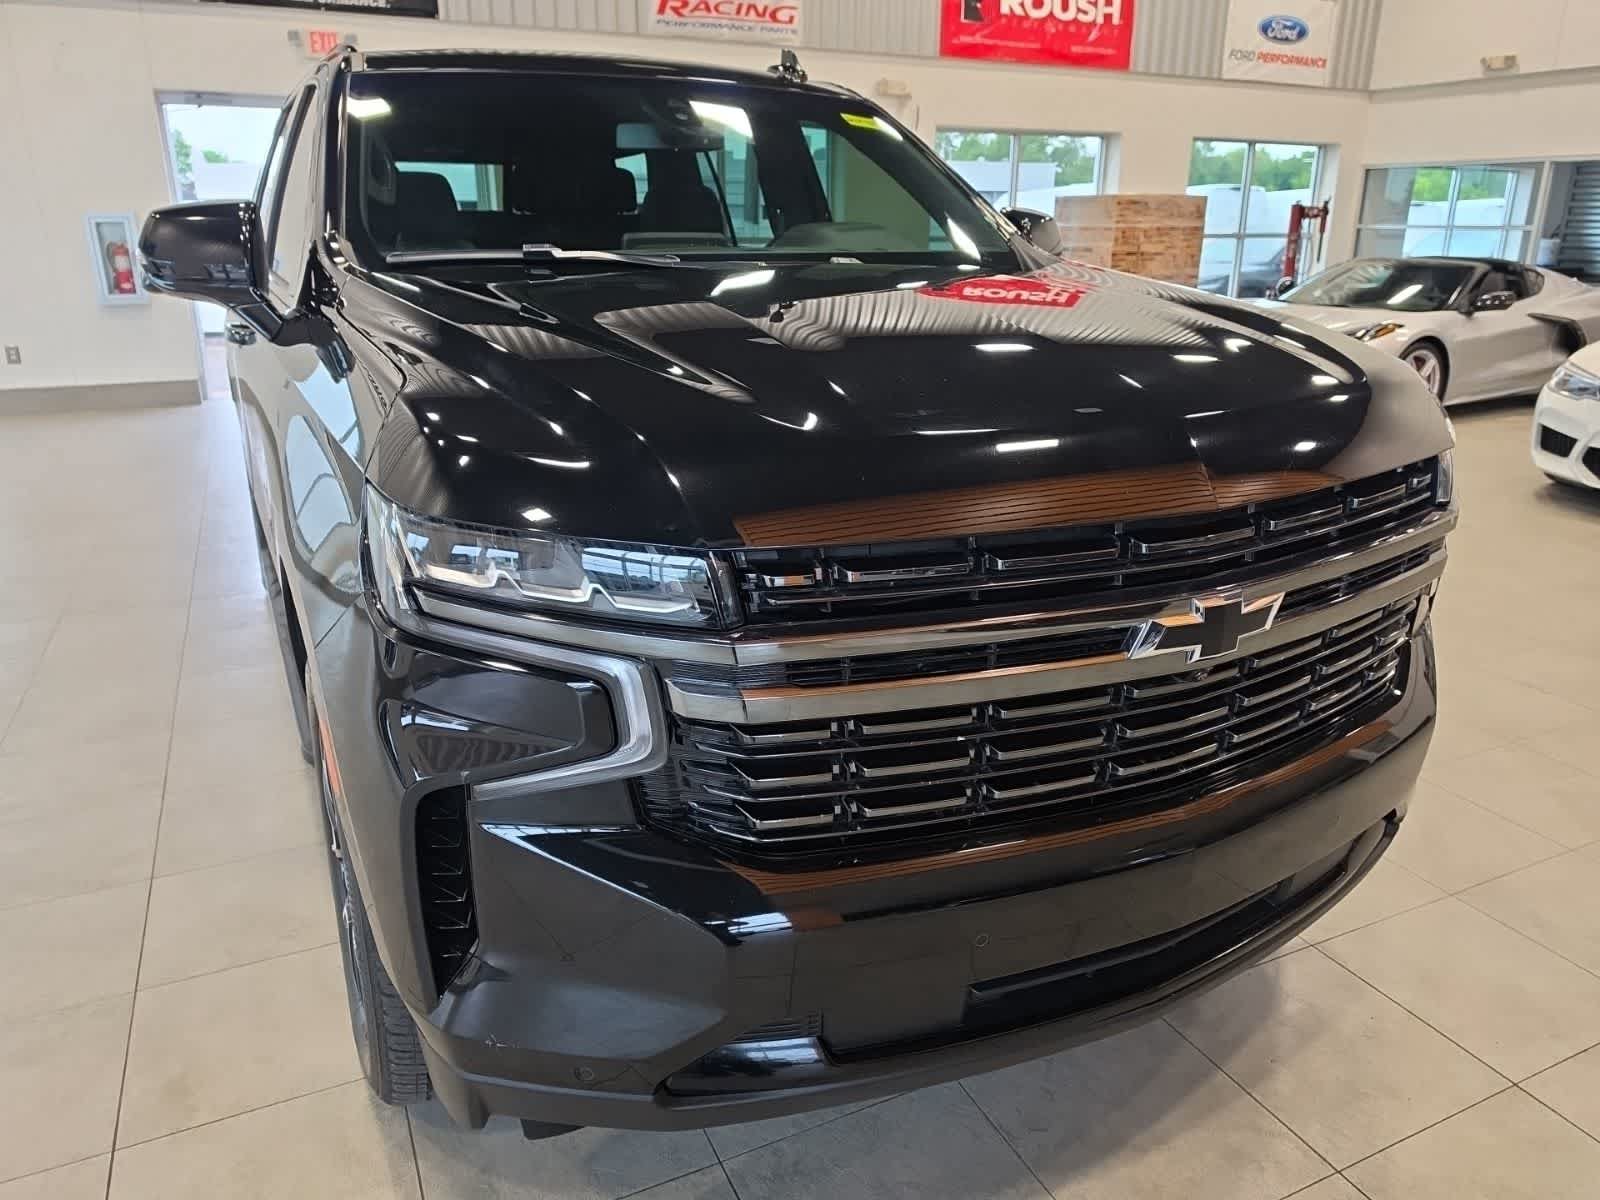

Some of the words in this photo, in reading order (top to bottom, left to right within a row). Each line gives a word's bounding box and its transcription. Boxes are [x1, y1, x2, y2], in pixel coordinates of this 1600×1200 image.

[656, 0, 798, 24] RACING
[656, 19, 753, 32] PERFORMANCE
[1267, 20, 1300, 40] Ford
[1229, 49, 1256, 61] FORD
[1257, 51, 1327, 68] PERFORMANCE
